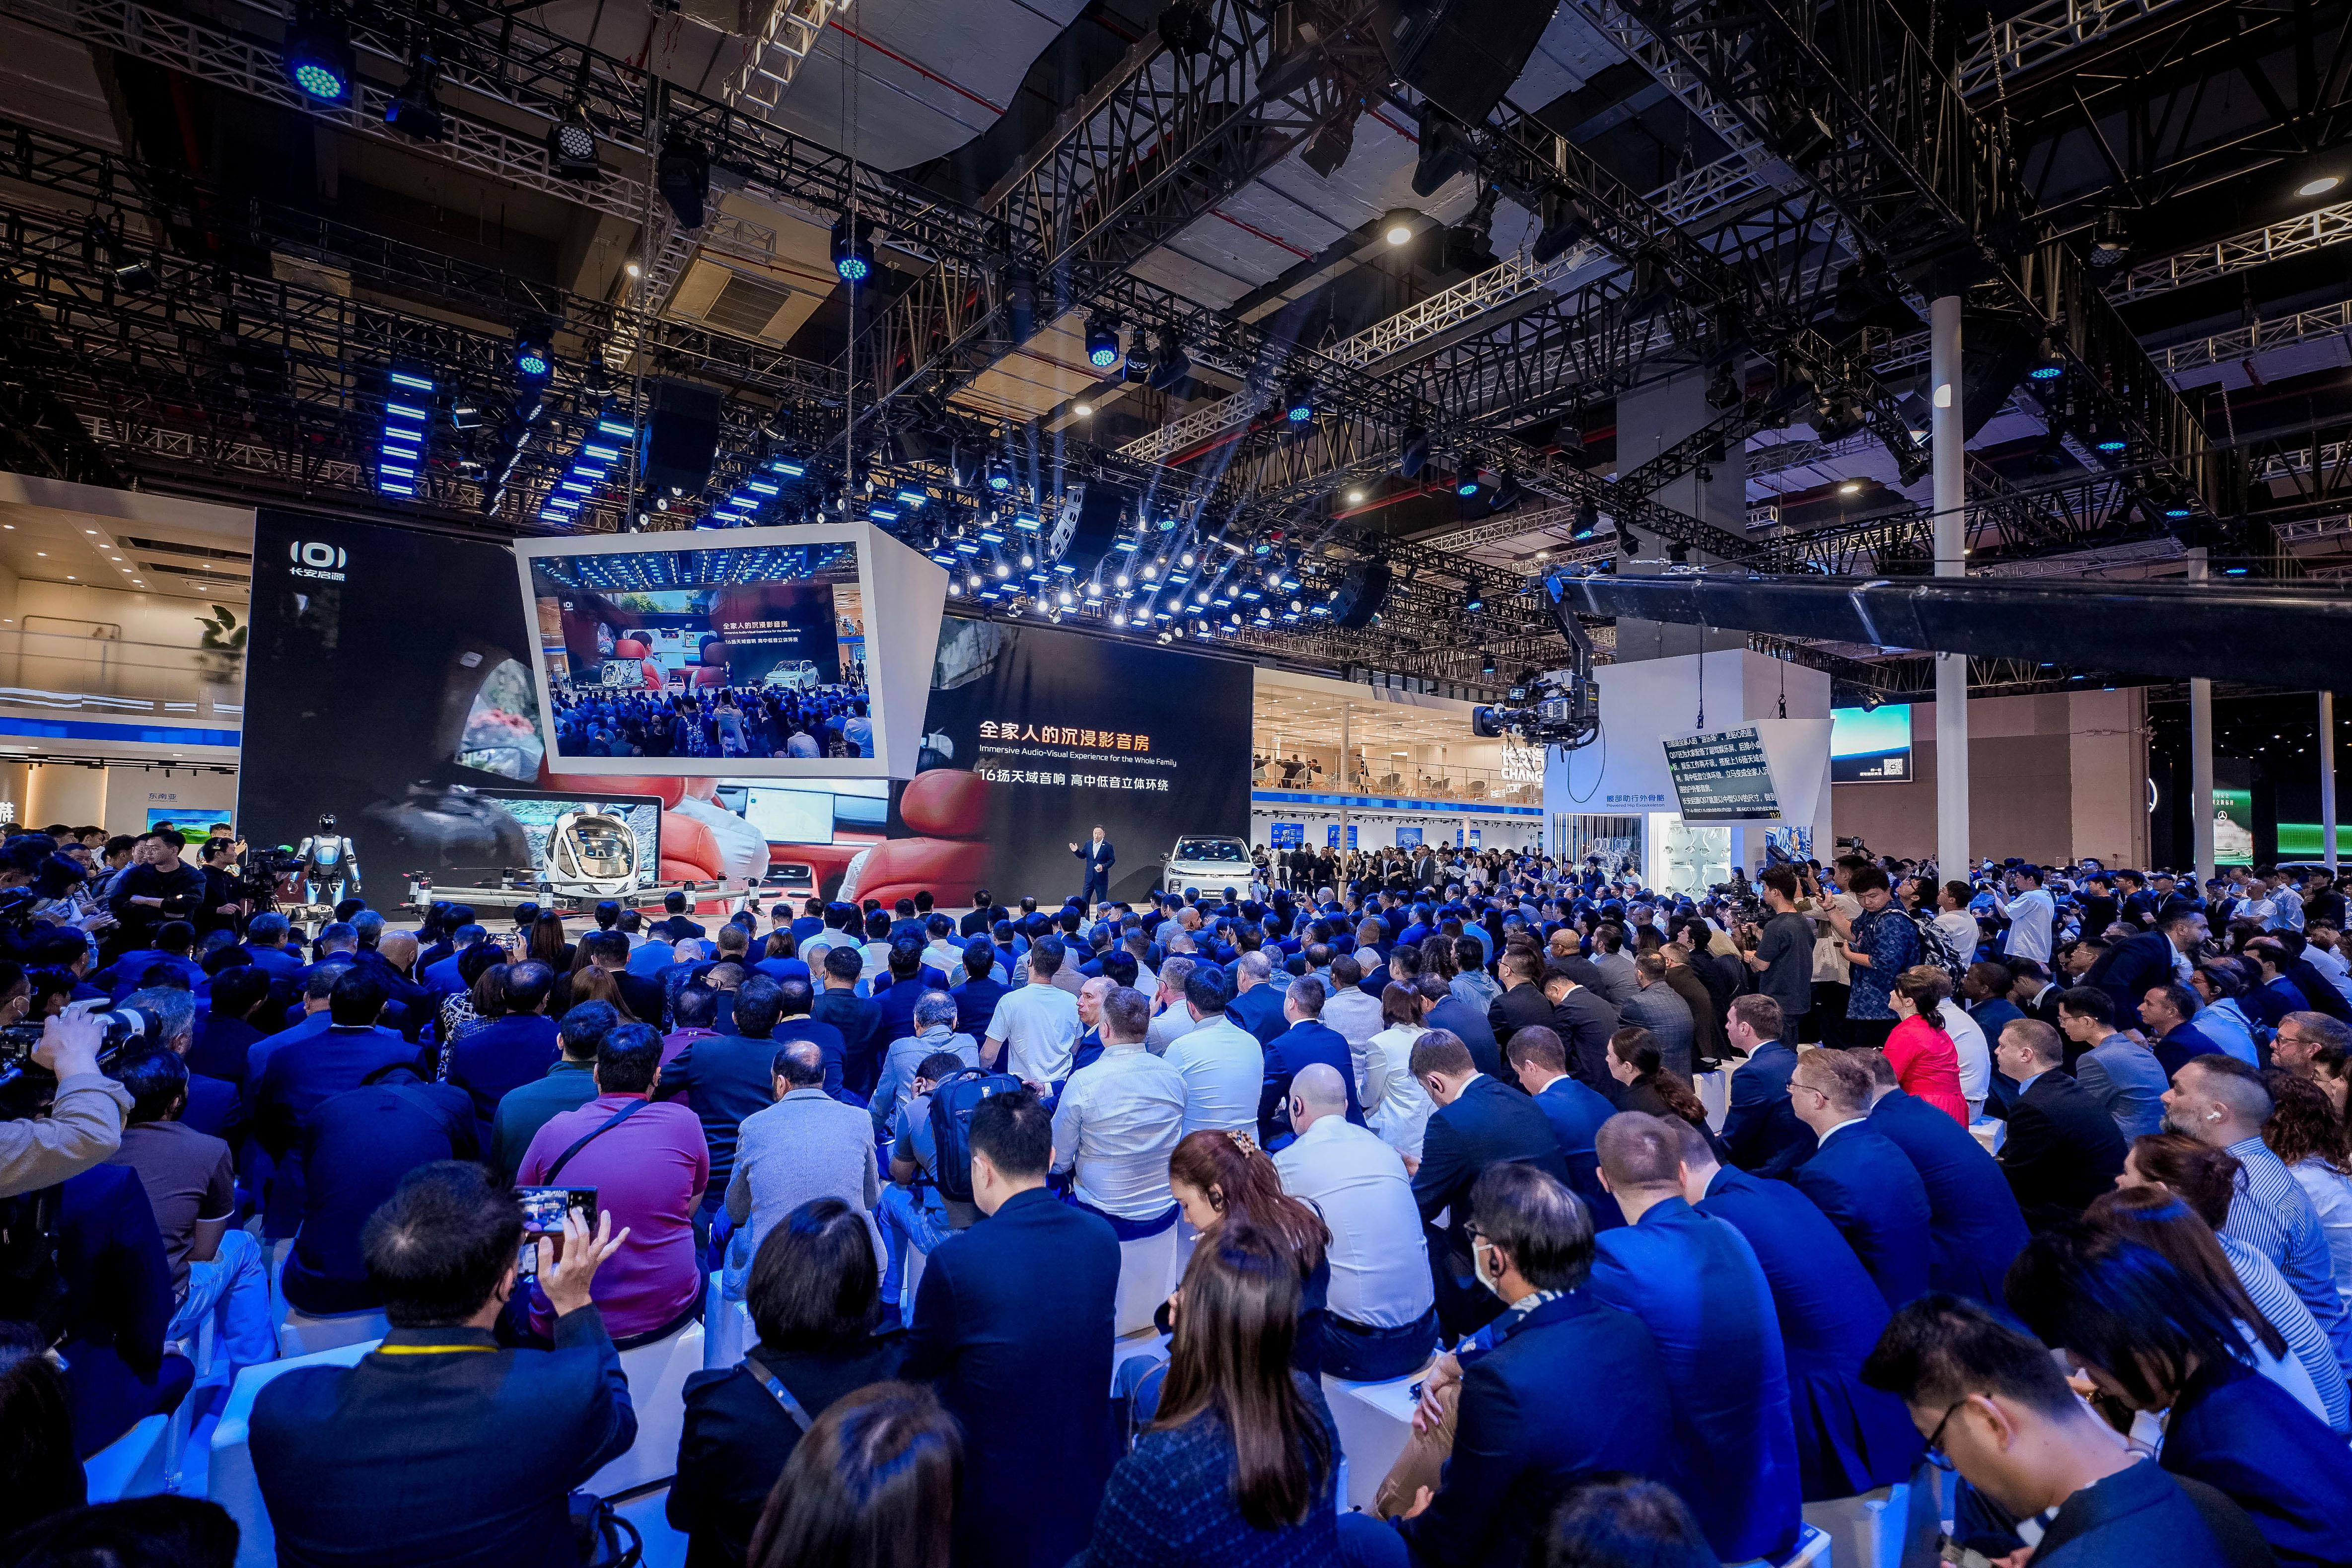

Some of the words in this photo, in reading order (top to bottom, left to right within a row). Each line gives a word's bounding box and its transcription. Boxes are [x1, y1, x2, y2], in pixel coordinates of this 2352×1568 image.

[289, 567, 345, 581] 长安启源
[723, 621, 788, 630] 全家人的沉浸影音房
[980, 720, 1150, 751] 全家人的沉浸影音房
[980, 744, 1020, 755] Immersive
[1021, 748, 1068, 758] Audio-Visual
[1070, 751, 1108, 761] Experience
[1156, 758, 1177, 767] Family
[979, 769, 1066, 785] 16扬天域音响
[1071, 774, 1169, 791] 高中低音立体环绕
